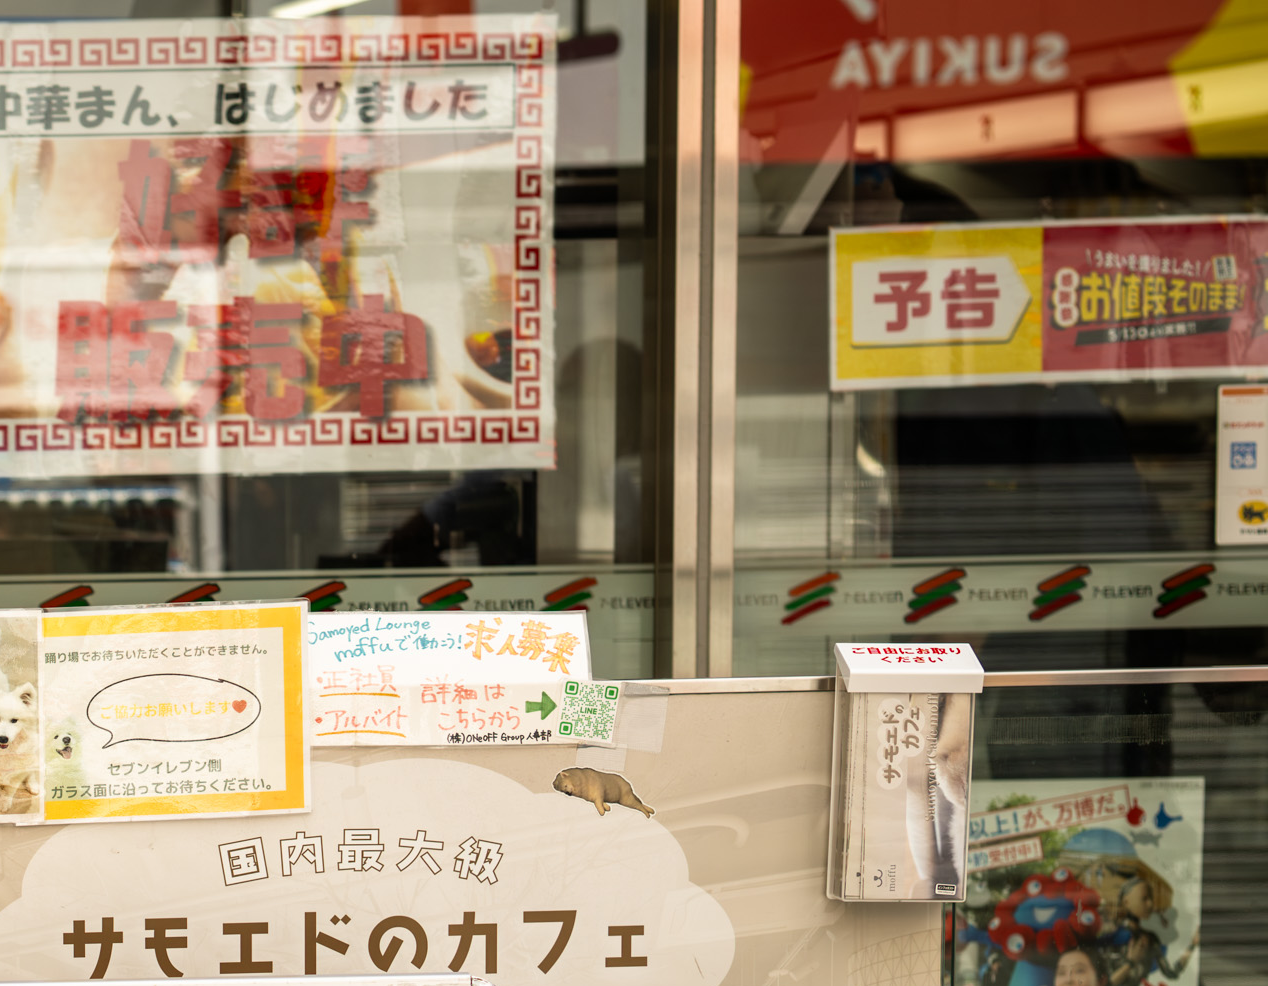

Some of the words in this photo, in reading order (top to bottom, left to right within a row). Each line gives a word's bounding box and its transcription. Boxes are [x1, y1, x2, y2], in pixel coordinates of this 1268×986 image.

[874, 268, 1000, 333] 予告
[375, 617, 431, 637] Lounge
[44, 644, 268, 665] 踊り場でお待ちいただくことができません。
[464, 617, 581, 675] 求人募集
[851, 646, 962, 656] ご自由にお取り
[881, 656, 944, 664] ください
[323, 665, 397, 692] 正社員
[100, 699, 232, 720] ご協力お願いします
[325, 705, 408, 731] アルバイト
[438, 706, 521, 731] こちらから
[579, 706, 598, 715] LINE
[500, 732, 525, 744] Group
[107, 758, 222, 777] セブンイレブン側
[51, 777, 272, 800] ガラス面に沿ってお待ちください。
[217, 827, 504, 886] 国内最大級
[889, 864, 897, 892] moffu
[63, 909, 649, 980] サモエドのカフェ
